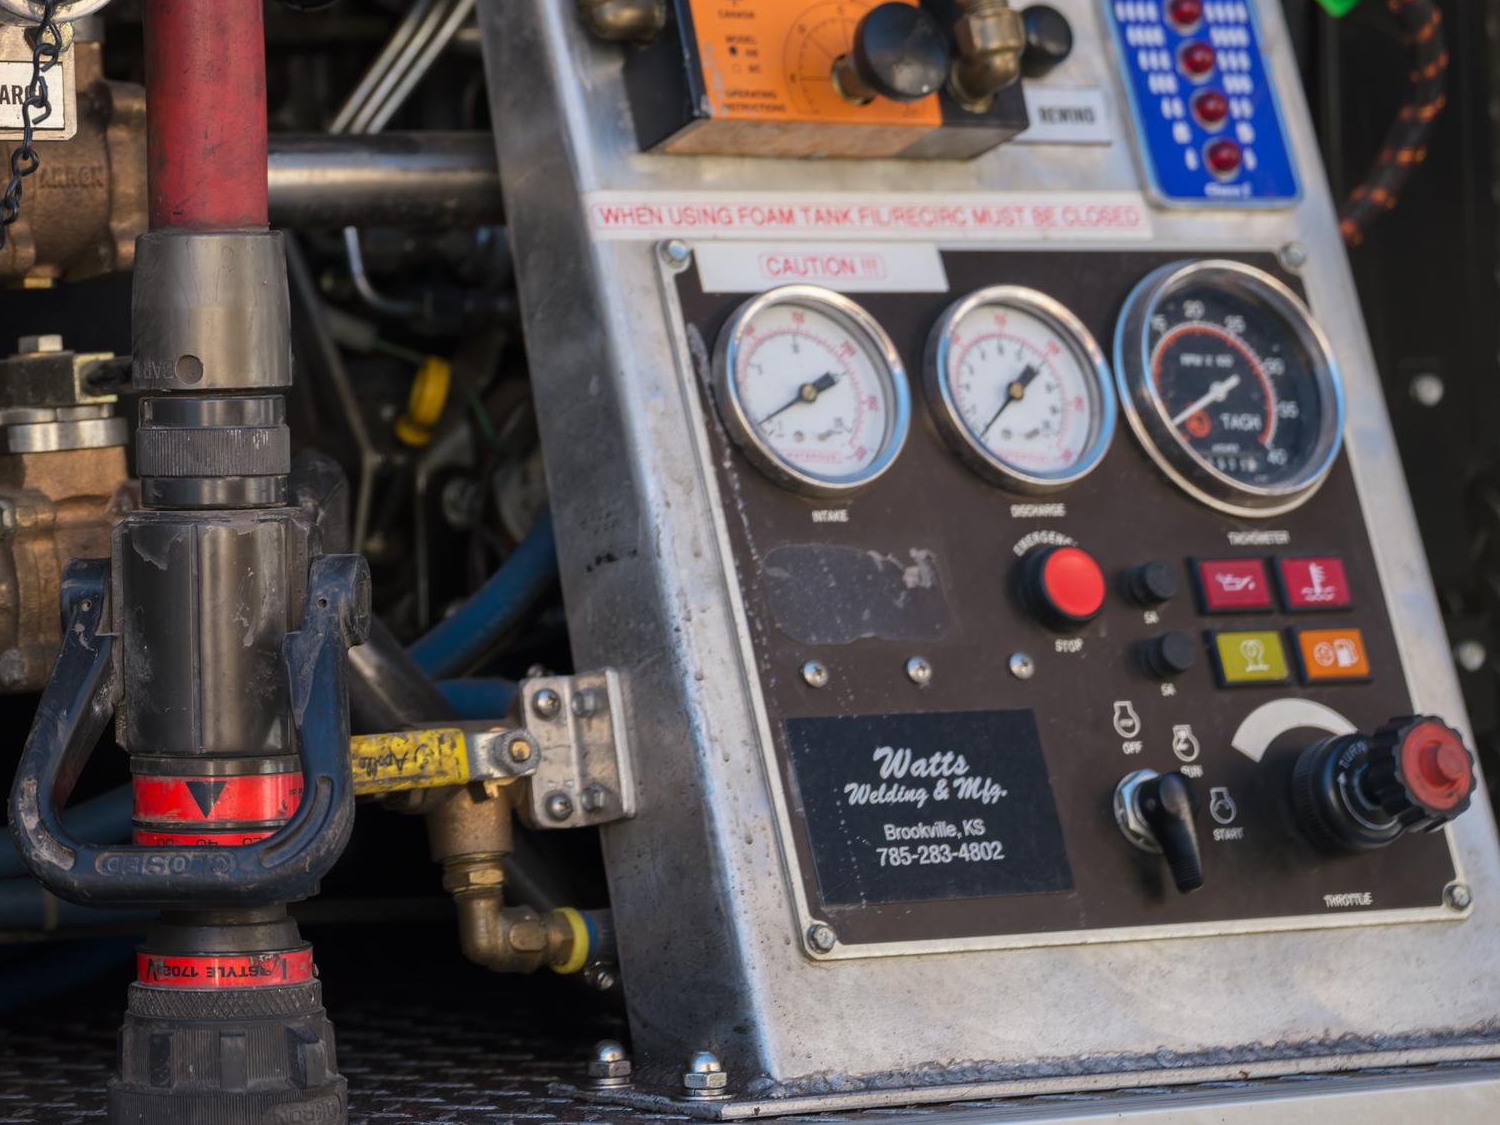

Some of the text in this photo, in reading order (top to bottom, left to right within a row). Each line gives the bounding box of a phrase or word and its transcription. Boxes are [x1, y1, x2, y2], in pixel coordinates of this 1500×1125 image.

[1038, 106, 1095, 125] REWIND
[599, 205, 664, 226] WHEN
[668, 205, 734, 226] USING
[737, 205, 796, 226] FOAM
[801, 205, 854, 226] TANK
[971, 205, 1025, 227] MUST
[1031, 205, 1056, 227] BE
[1061, 205, 1140, 227] CLOSED
[765, 256, 855, 276] CAUTION
[1182, 299, 1205, 319] 20
[1224, 314, 1246, 334] 25
[1264, 357, 1285, 376] 30
[1277, 401, 1299, 419] 35
[1219, 413, 1262, 432] TACH
[1267, 447, 1288, 466] 40
[811, 509, 849, 524] INTAKE
[1010, 503, 1066, 518] DISCHARGE
[1013, 529, 1078, 558] EMERGENC
[1055, 638, 1084, 653] STOP
[1122, 740, 1143, 755] OFF
[872, 745, 971, 780] Watts
[843, 776, 1009, 809] Welding & Mfg.
[883, 818, 987, 841] Brookville, KS
[1213, 827, 1245, 842] START
[875, 840, 1007, 868] 785-283-4802
[104, 855, 230, 874] COSED
[1323, 890, 1373, 908] THROTTLE
